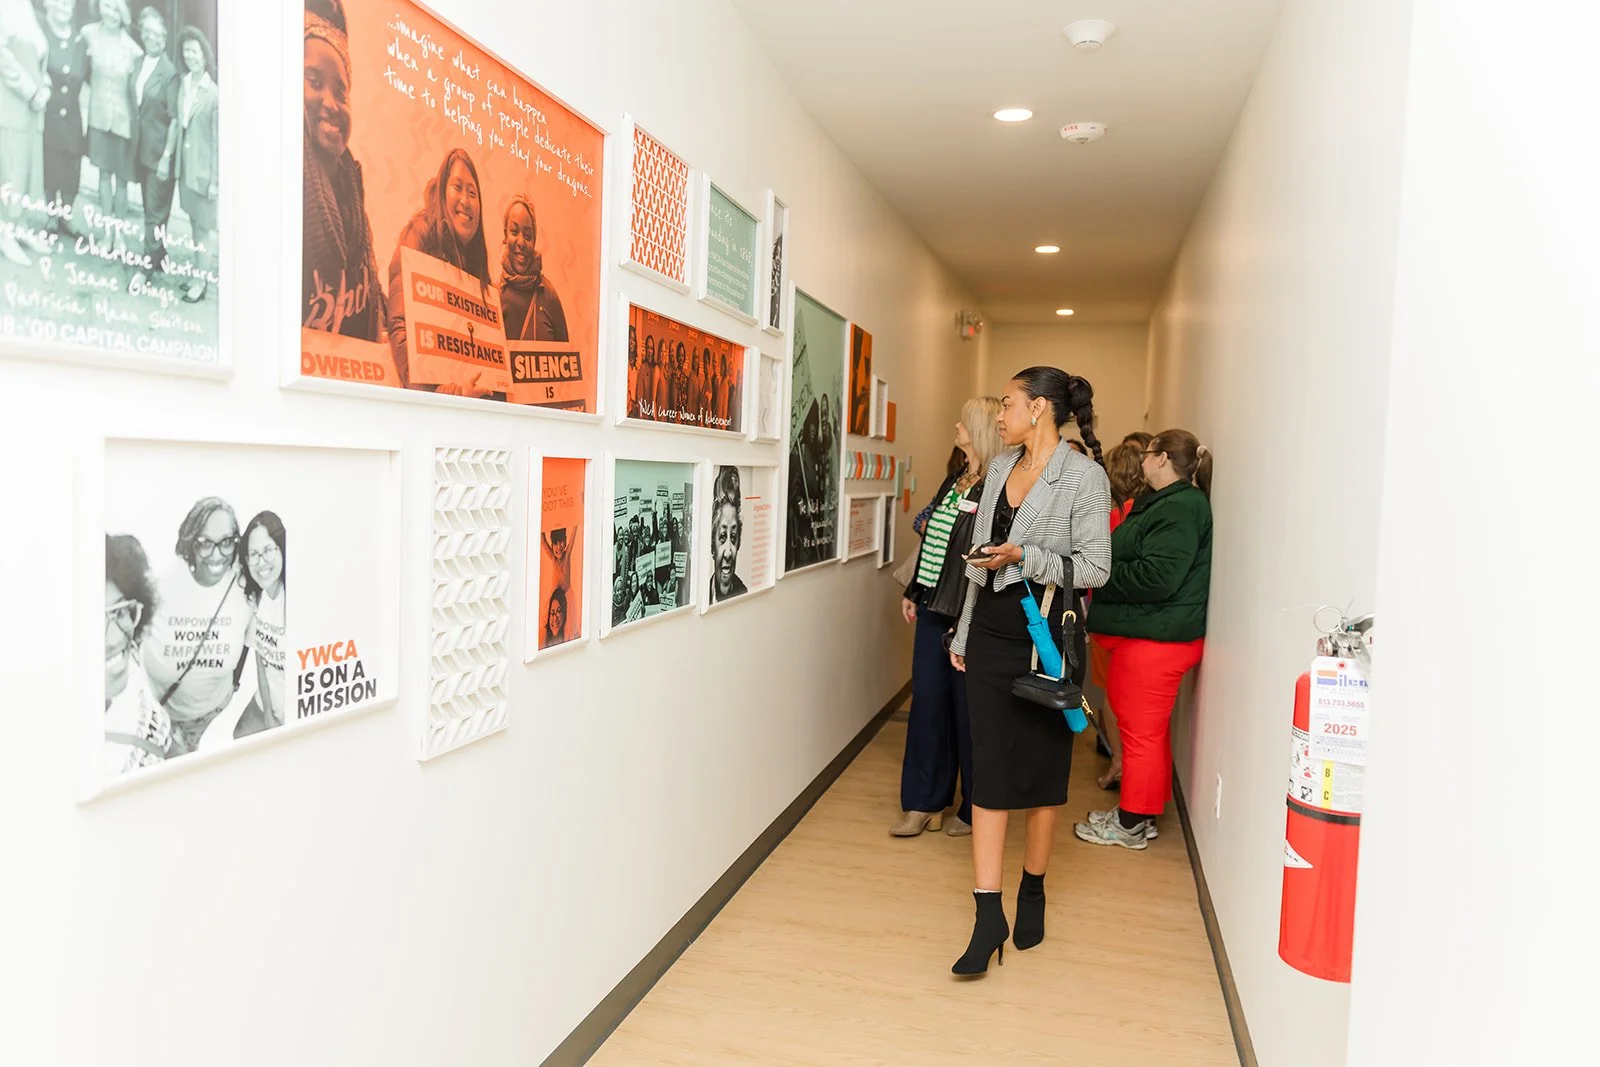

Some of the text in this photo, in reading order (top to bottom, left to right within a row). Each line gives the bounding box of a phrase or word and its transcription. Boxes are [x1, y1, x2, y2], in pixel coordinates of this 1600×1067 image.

[452, 50, 481, 81] what
[487, 79, 508, 100] can
[513, 86, 548, 126] happen
[384, 65, 416, 100] time
[421, 87, 437, 109] to
[443, 95, 483, 146] helping
[489, 128, 505, 150] you
[510, 142, 531, 169] slay
[535, 155, 553, 175] your
[387, 37, 595, 177] when a group of people dedicate their
[74, 232, 153, 269] Charlene
[415, 280, 498, 325] OUR EXISTENCE
[60, 323, 135, 351] CAPITAL
[137, 335, 218, 363] CAMPAIGN
[419, 328, 505, 365] IS RESISTANCE
[513, 353, 580, 380] SILENCE
[545, 386, 554, 399] IS
[297, 640, 358, 670] YWCA
[298, 660, 365, 695] IS ON A
[297, 678, 377, 720] MISSION
[1318, 698, 1365, 709] 513.733.5655
[1323, 722, 1358, 736] 2025
[1325, 768, 1331, 778] B
[1323, 791, 1329, 801] C
